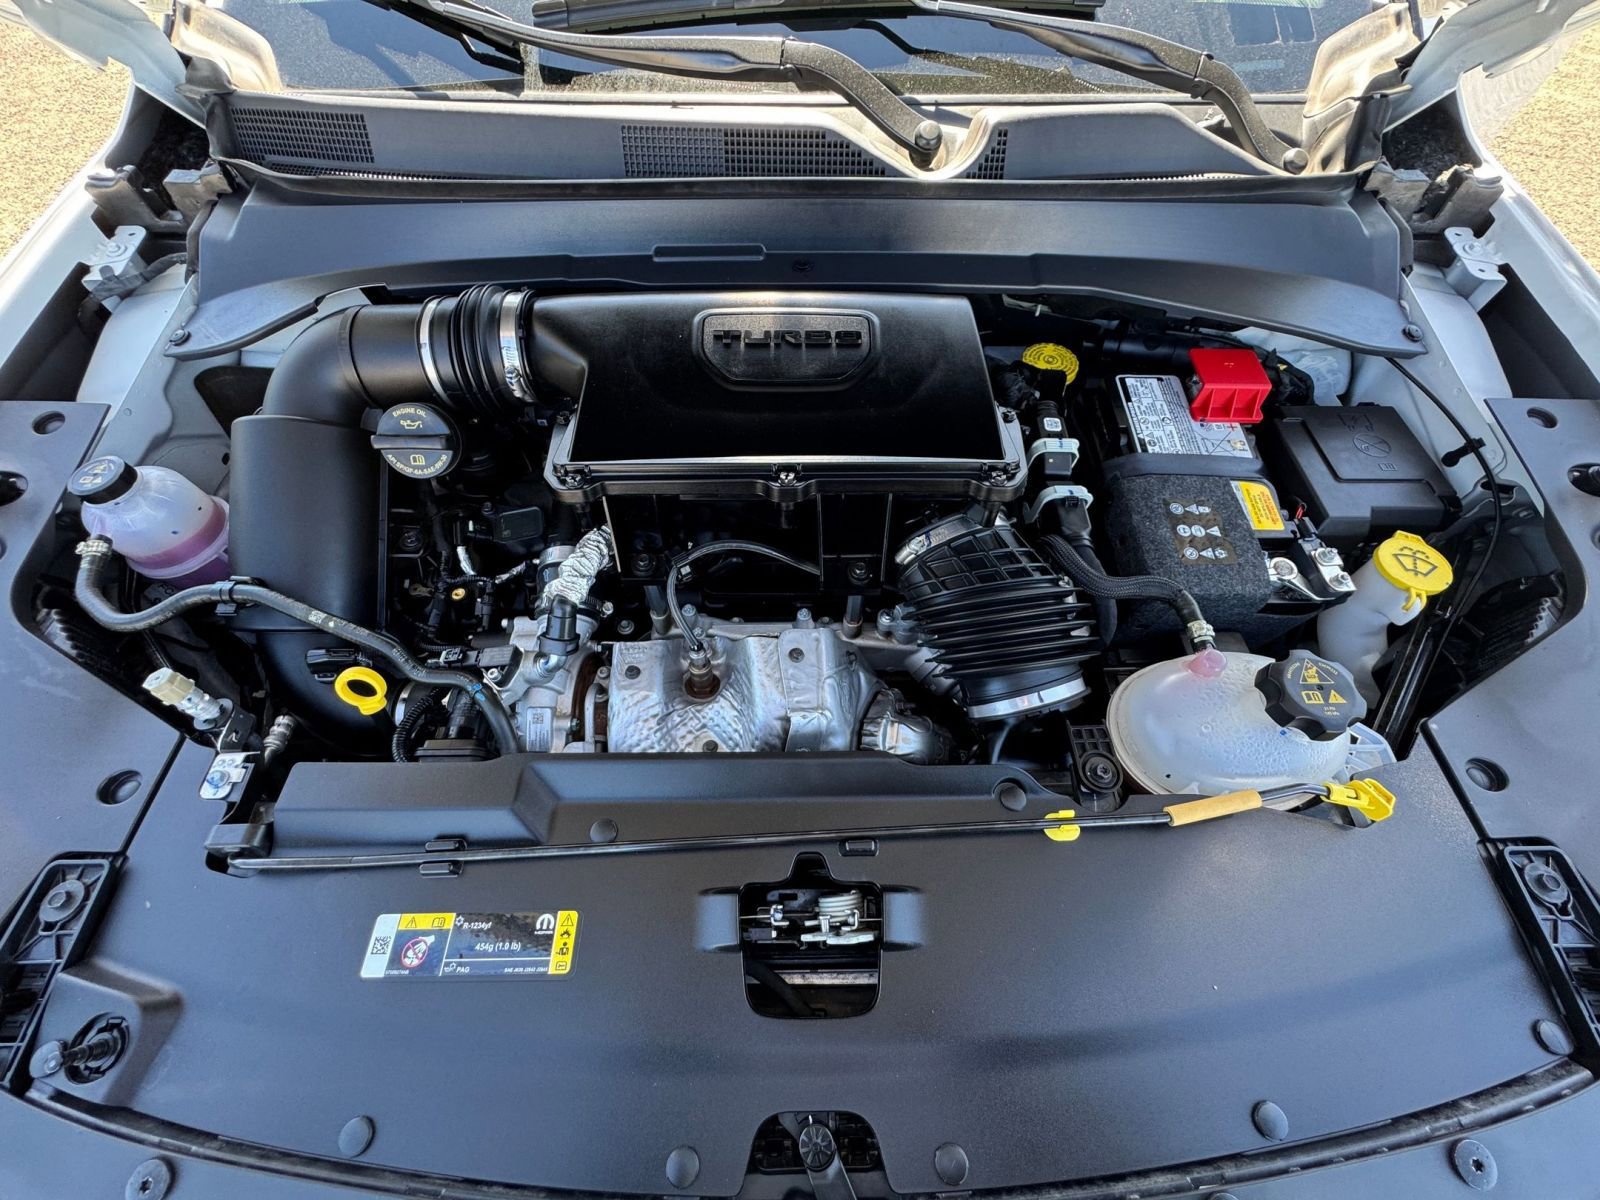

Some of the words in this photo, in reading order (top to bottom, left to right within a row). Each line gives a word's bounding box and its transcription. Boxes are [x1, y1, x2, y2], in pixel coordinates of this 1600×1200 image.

[712, 329, 863, 346] TURBO
[392, 408, 415, 417] ENGINE
[416, 408, 427, 418] OIL
[386, 454, 397, 464] API
[463, 921, 492, 930] R-1234yf
[474, 942, 494, 952] 454g
[495, 942, 509, 952] (1.0
[510, 942, 522, 952] lb)
